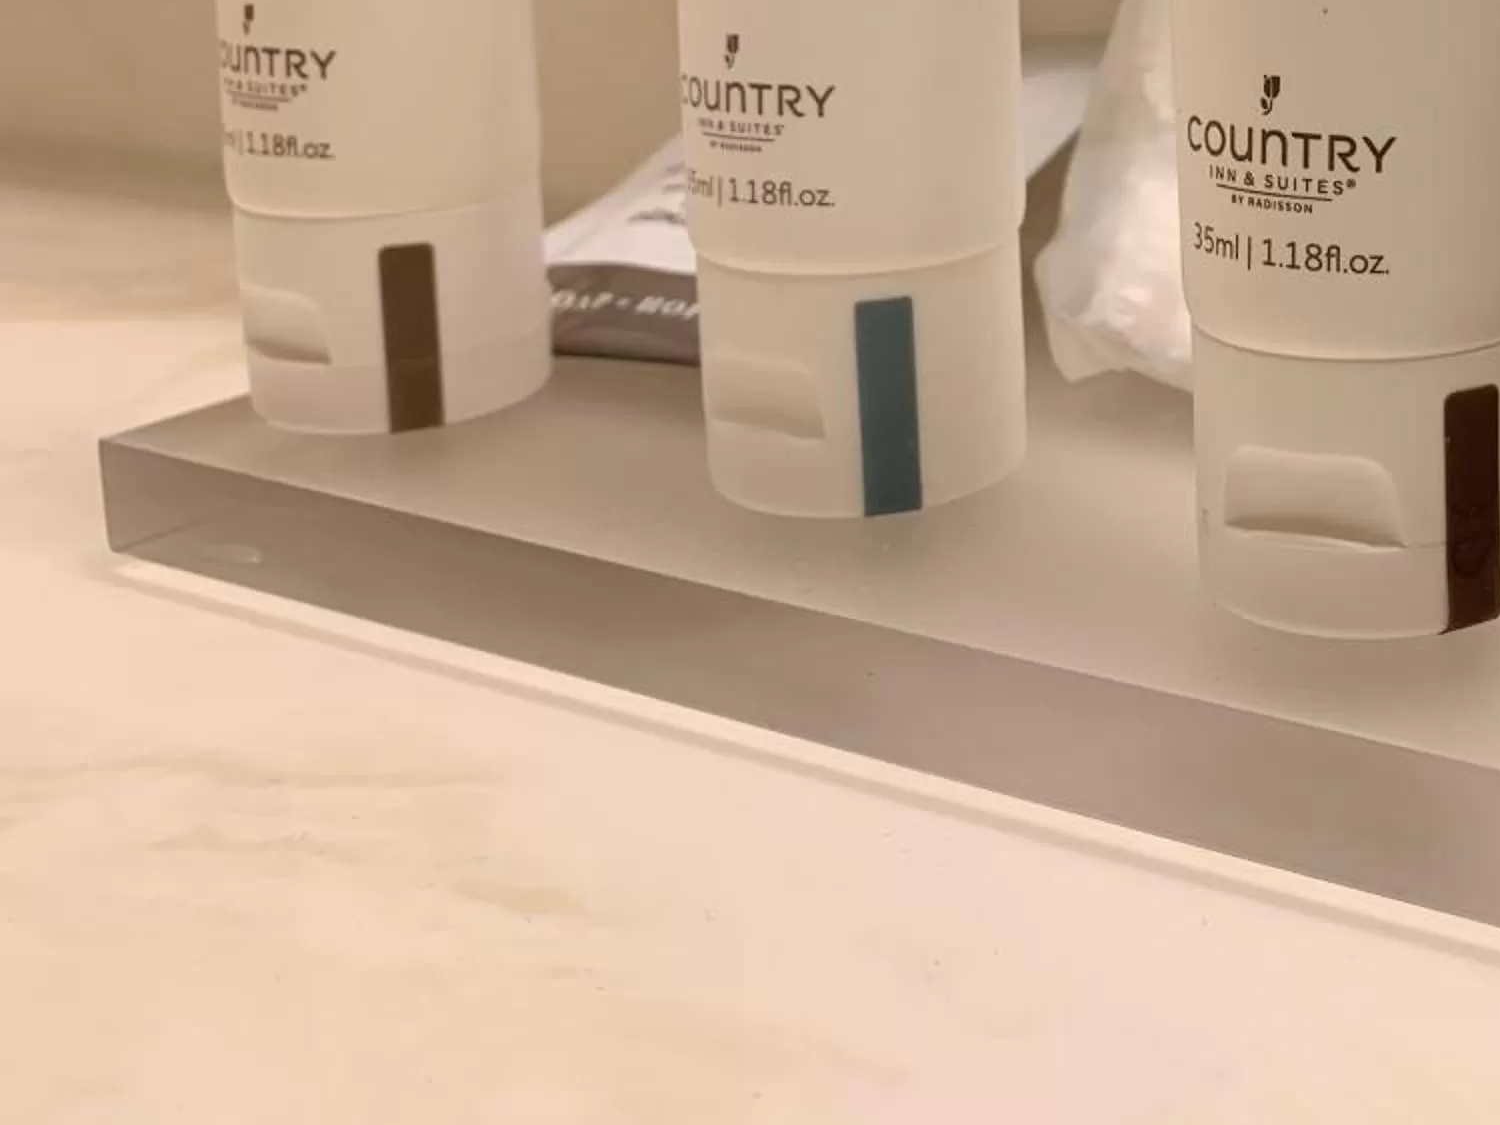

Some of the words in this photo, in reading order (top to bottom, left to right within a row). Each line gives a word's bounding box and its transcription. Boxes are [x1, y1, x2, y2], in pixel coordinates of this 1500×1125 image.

[1209, 164, 1237, 183] INN
[1243, 170, 1255, 187] &
[1231, 193, 1245, 204] BY
[1247, 195, 1313, 214] RADISSON
